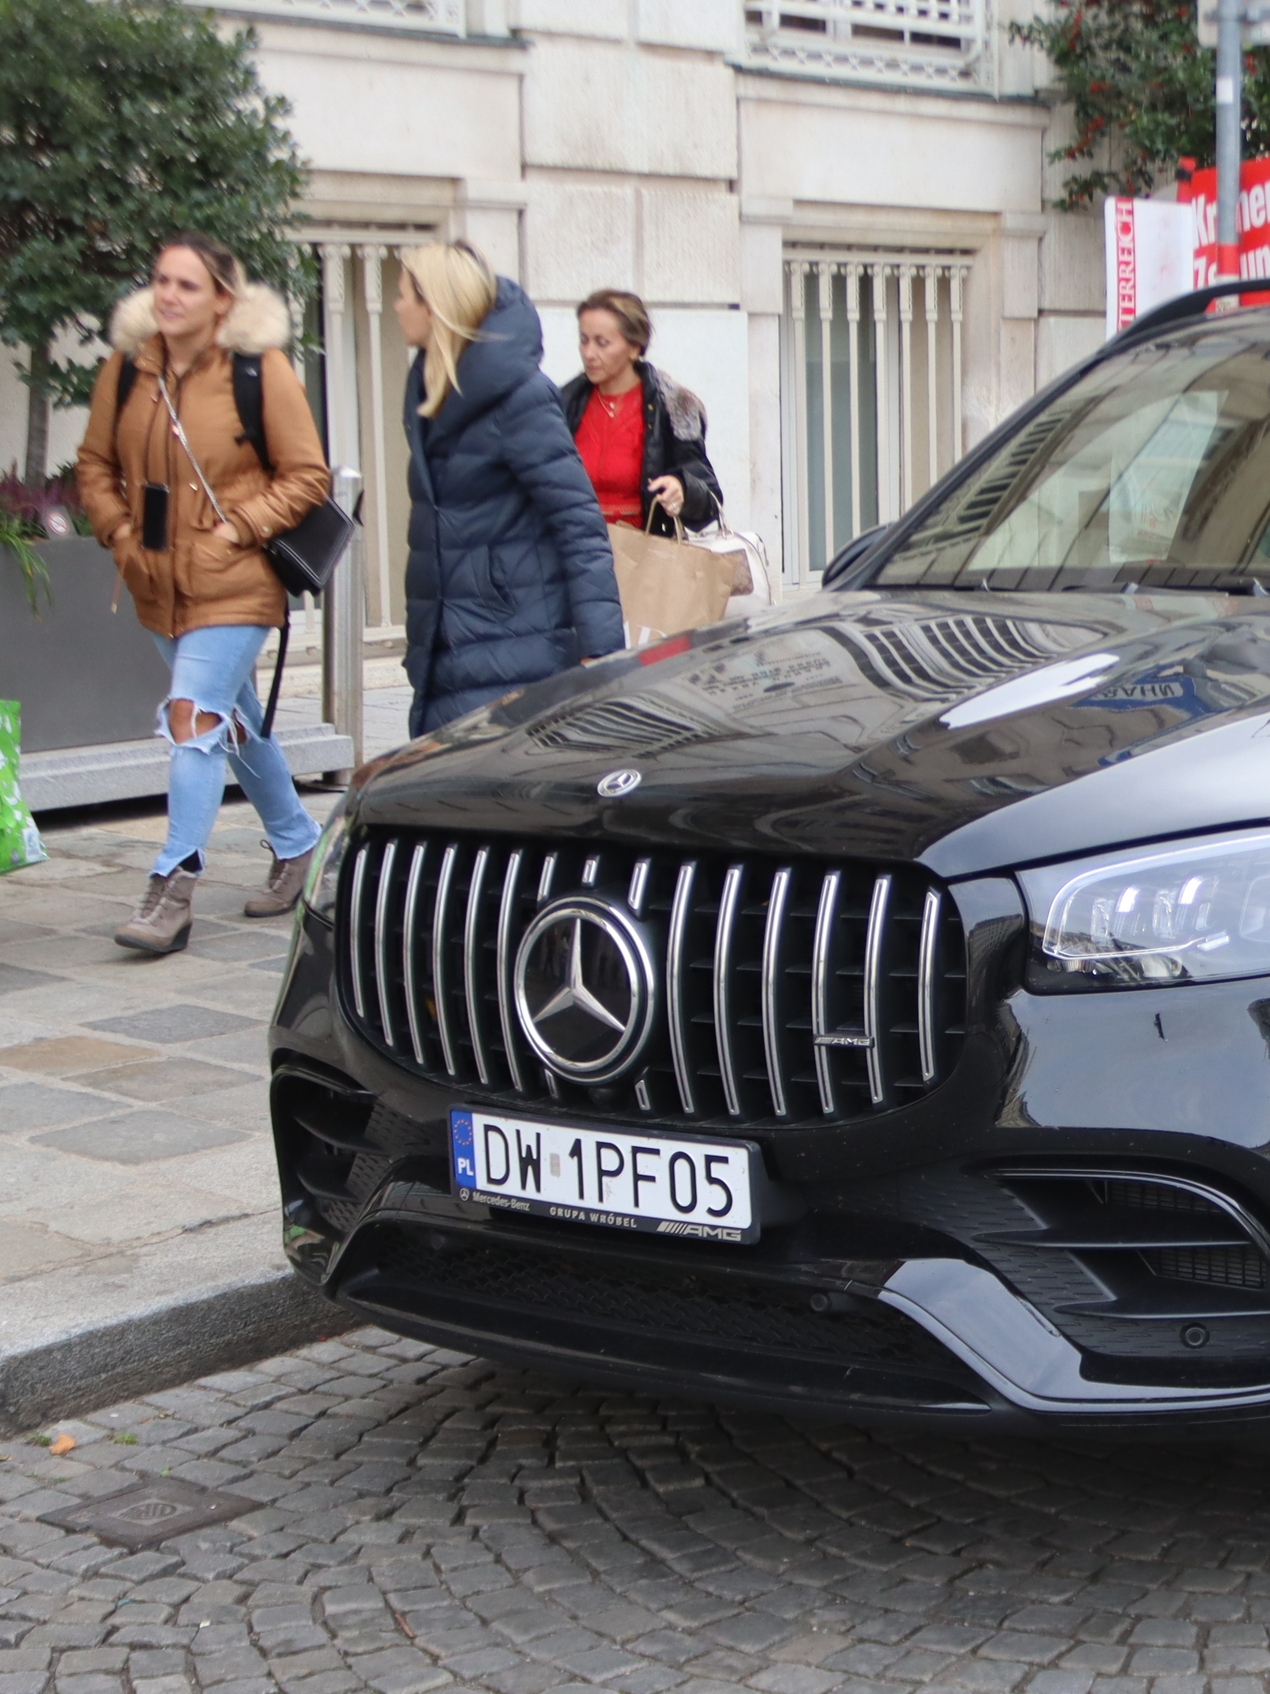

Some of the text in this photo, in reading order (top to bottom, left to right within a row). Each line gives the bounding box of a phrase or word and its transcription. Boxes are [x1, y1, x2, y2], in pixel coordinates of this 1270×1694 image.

[1115, 201, 1135, 326] TERREICH
[457, 1157, 474, 1177] PL
[483, 1123, 734, 1218] DW 1PF05
[472, 1191, 530, 1212] Mercedes-Benz
[550, 1206, 637, 1228] GRUPA WRÓBEL
